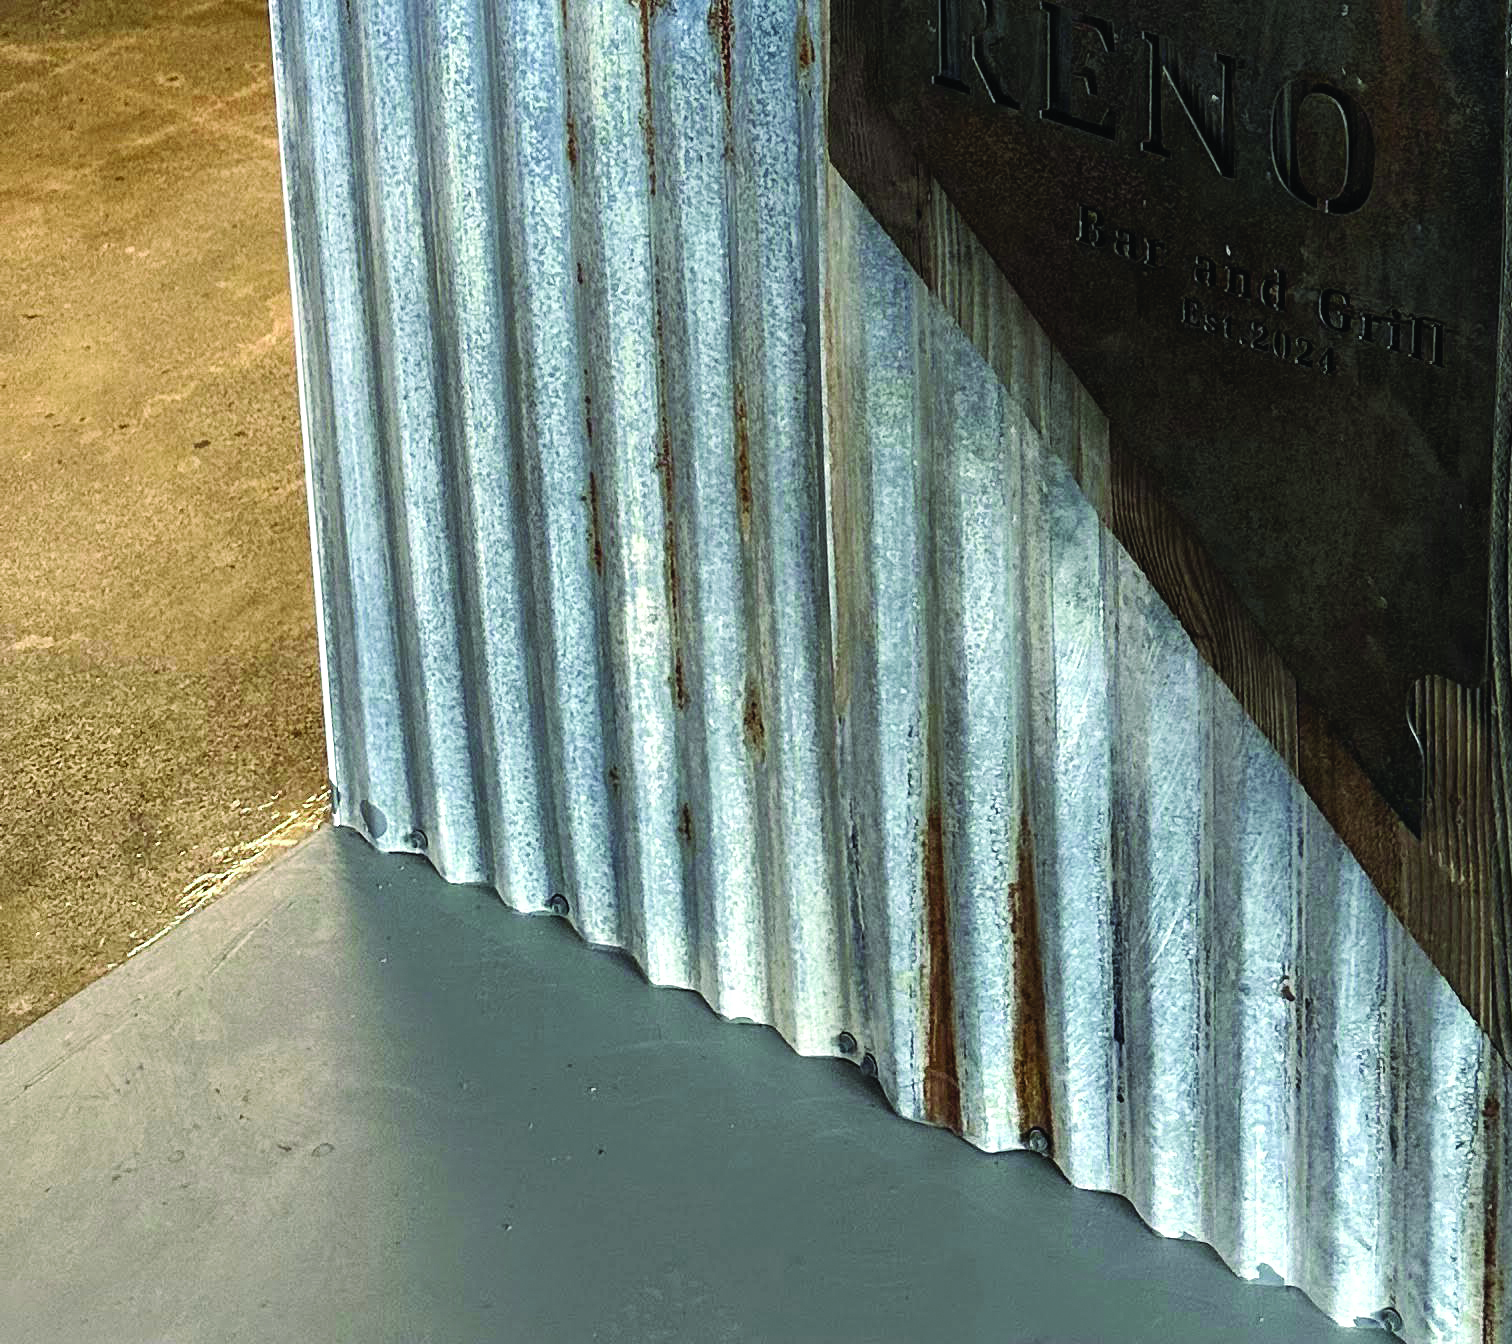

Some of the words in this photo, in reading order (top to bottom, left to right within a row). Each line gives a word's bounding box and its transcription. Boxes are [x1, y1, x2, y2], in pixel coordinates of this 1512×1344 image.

[1075, 202, 1168, 269] Bar
[1192, 252, 1288, 312] and
[1317, 287, 1446, 368] Grill
